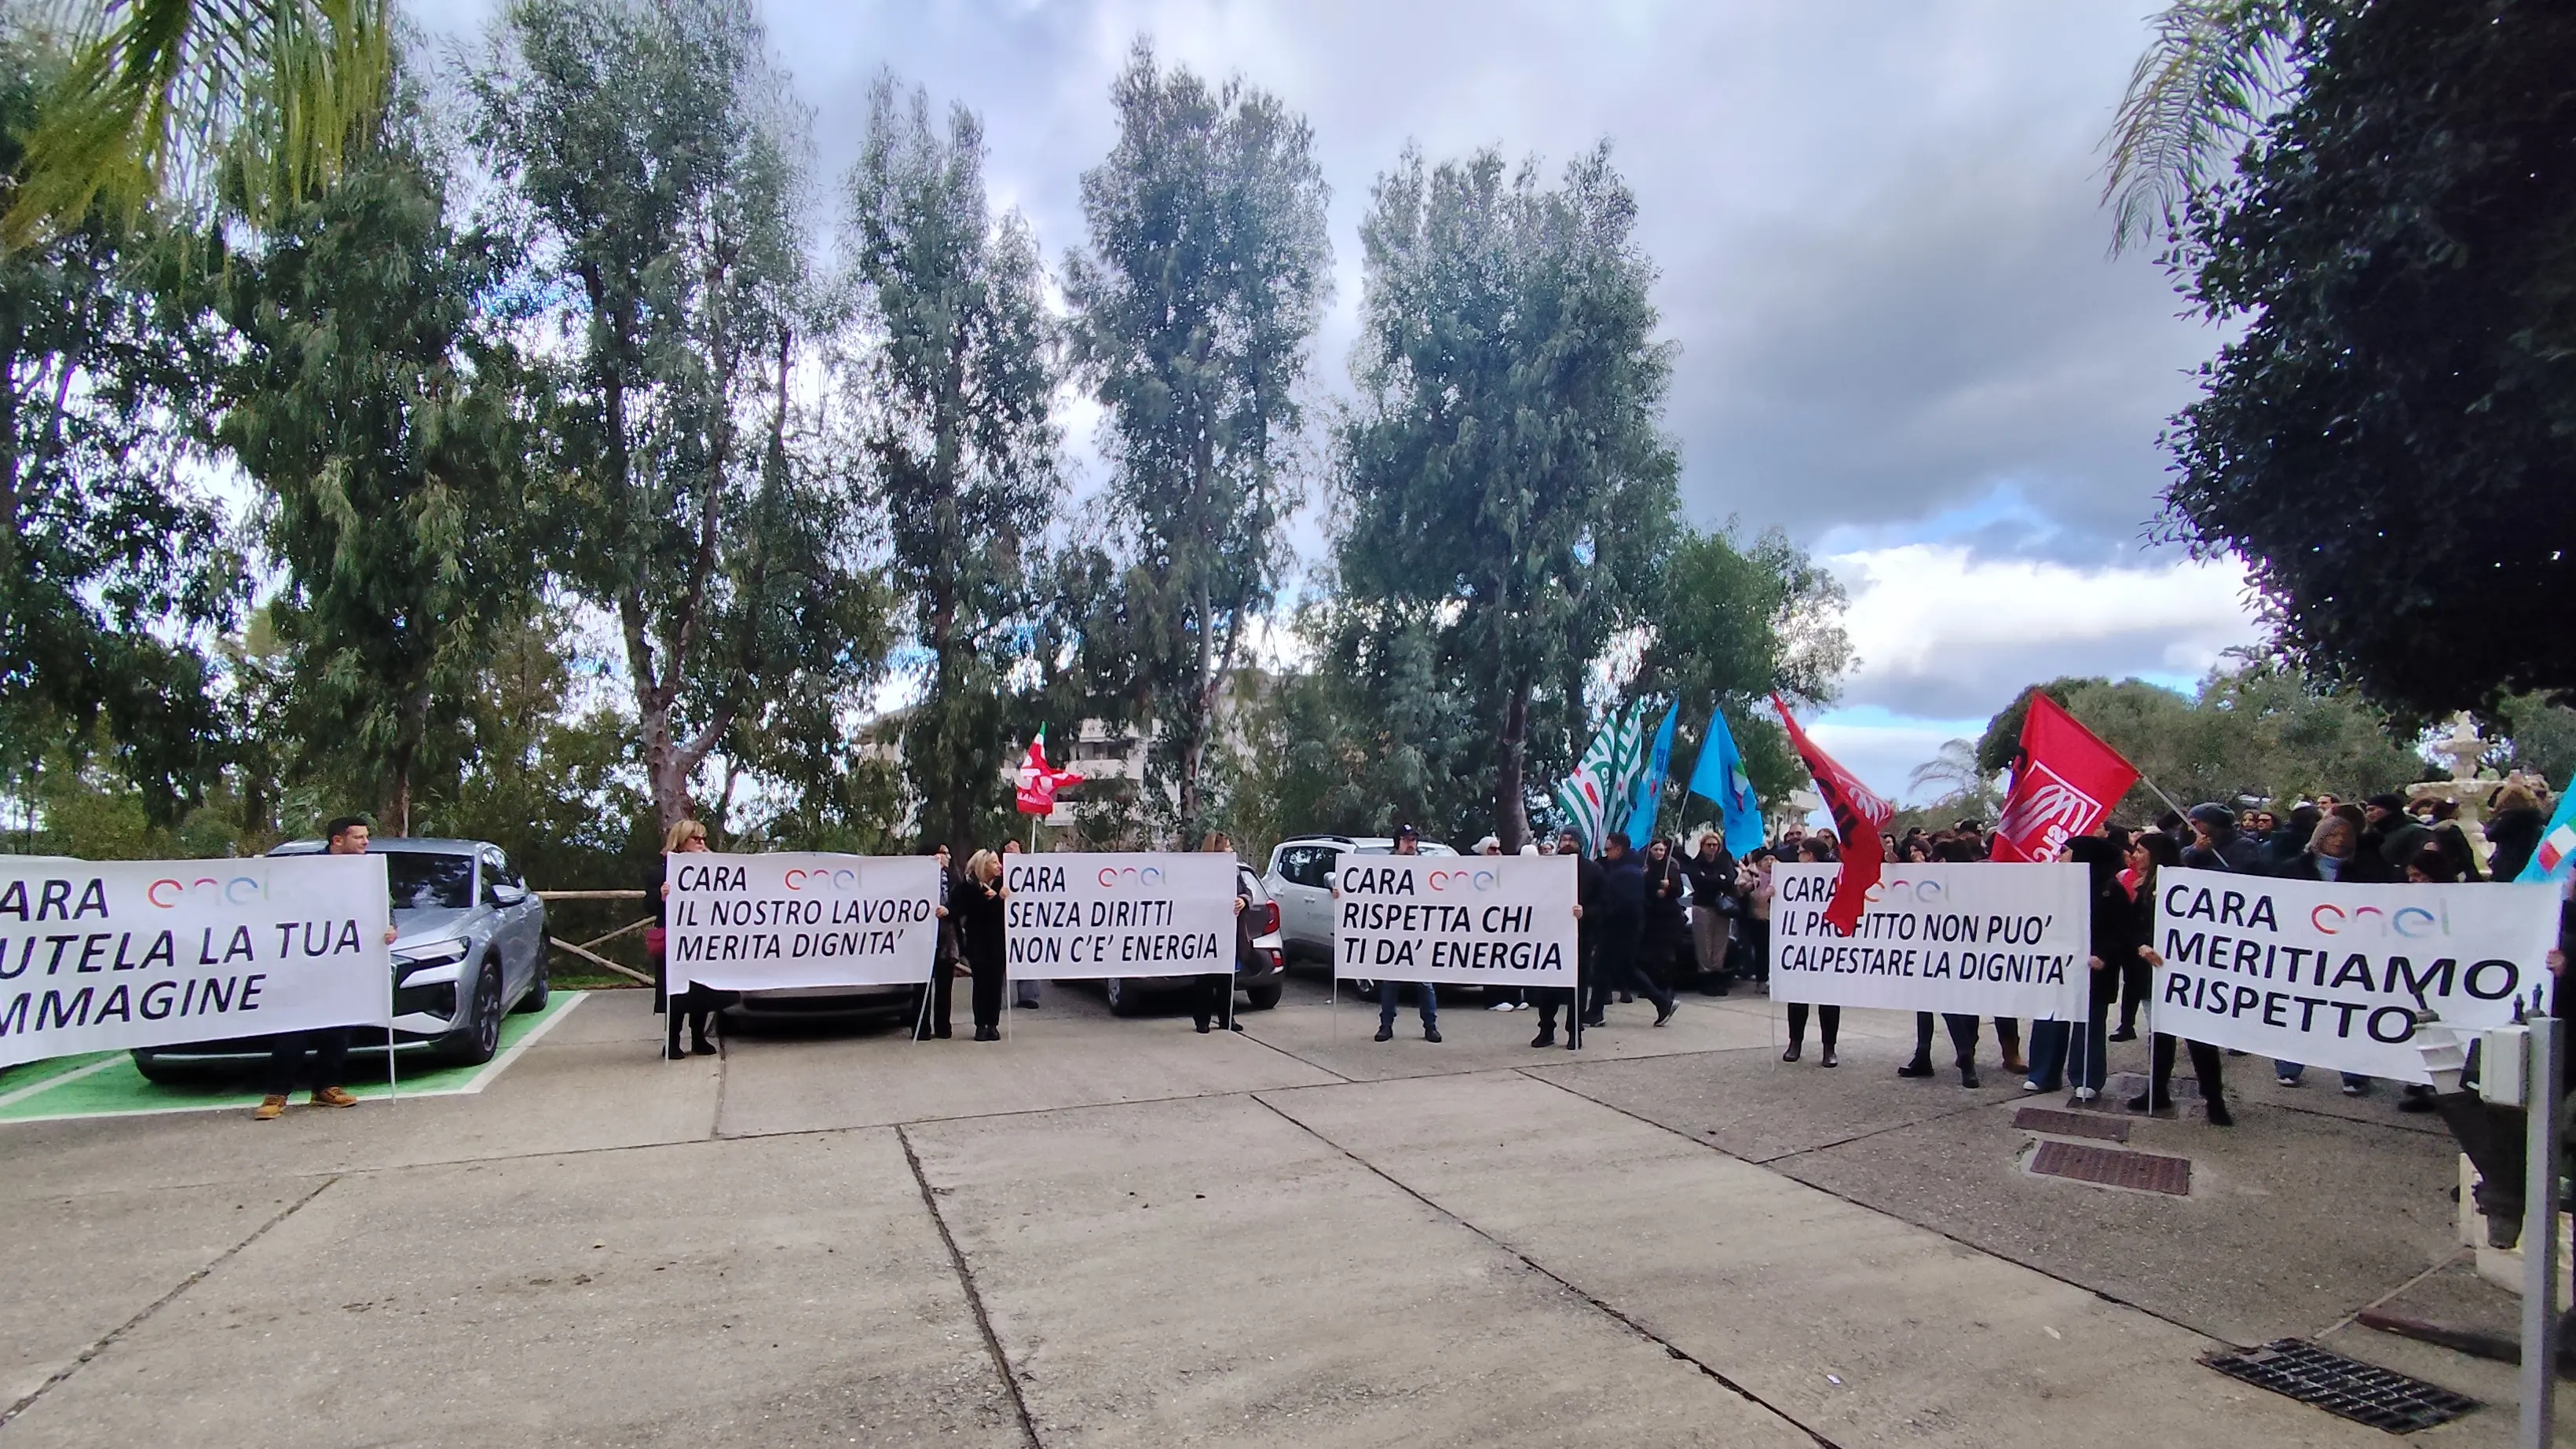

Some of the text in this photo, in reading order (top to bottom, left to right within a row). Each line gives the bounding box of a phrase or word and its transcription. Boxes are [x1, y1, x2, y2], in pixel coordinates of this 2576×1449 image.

[147, 869, 270, 909] enel
[678, 864, 862, 892] CARA enel
[1008, 865, 1166, 893] CARA enel
[1343, 865, 1501, 896] CARA enel
[1783, 876, 1837, 902] CARA
[676, 898, 931, 927] IL NOSTRO LAVORO
[1008, 899, 1173, 928] SENZA DIRITTI
[1342, 902, 1533, 933] RISPETTA CHI
[1781, 910, 1798, 936] IL
[1923, 913, 1980, 943] NON
[2165, 884, 2451, 939] CARA enel
[199, 925, 254, 965] LA
[275, 919, 360, 959] TUA
[675, 934, 781, 962] MERITA
[1008, 936, 1062, 964] NON
[1122, 932, 1218, 962] ENERGIA
[1344, 937, 1367, 964] TI
[1431, 941, 1562, 971] ENERGIA
[1780, 944, 1918, 977] CALPESTARE
[1923, 950, 1951, 979] LA
[2165, 928, 2519, 1000] MERITIAMO
[2165, 972, 2417, 1044] RISPETTO
